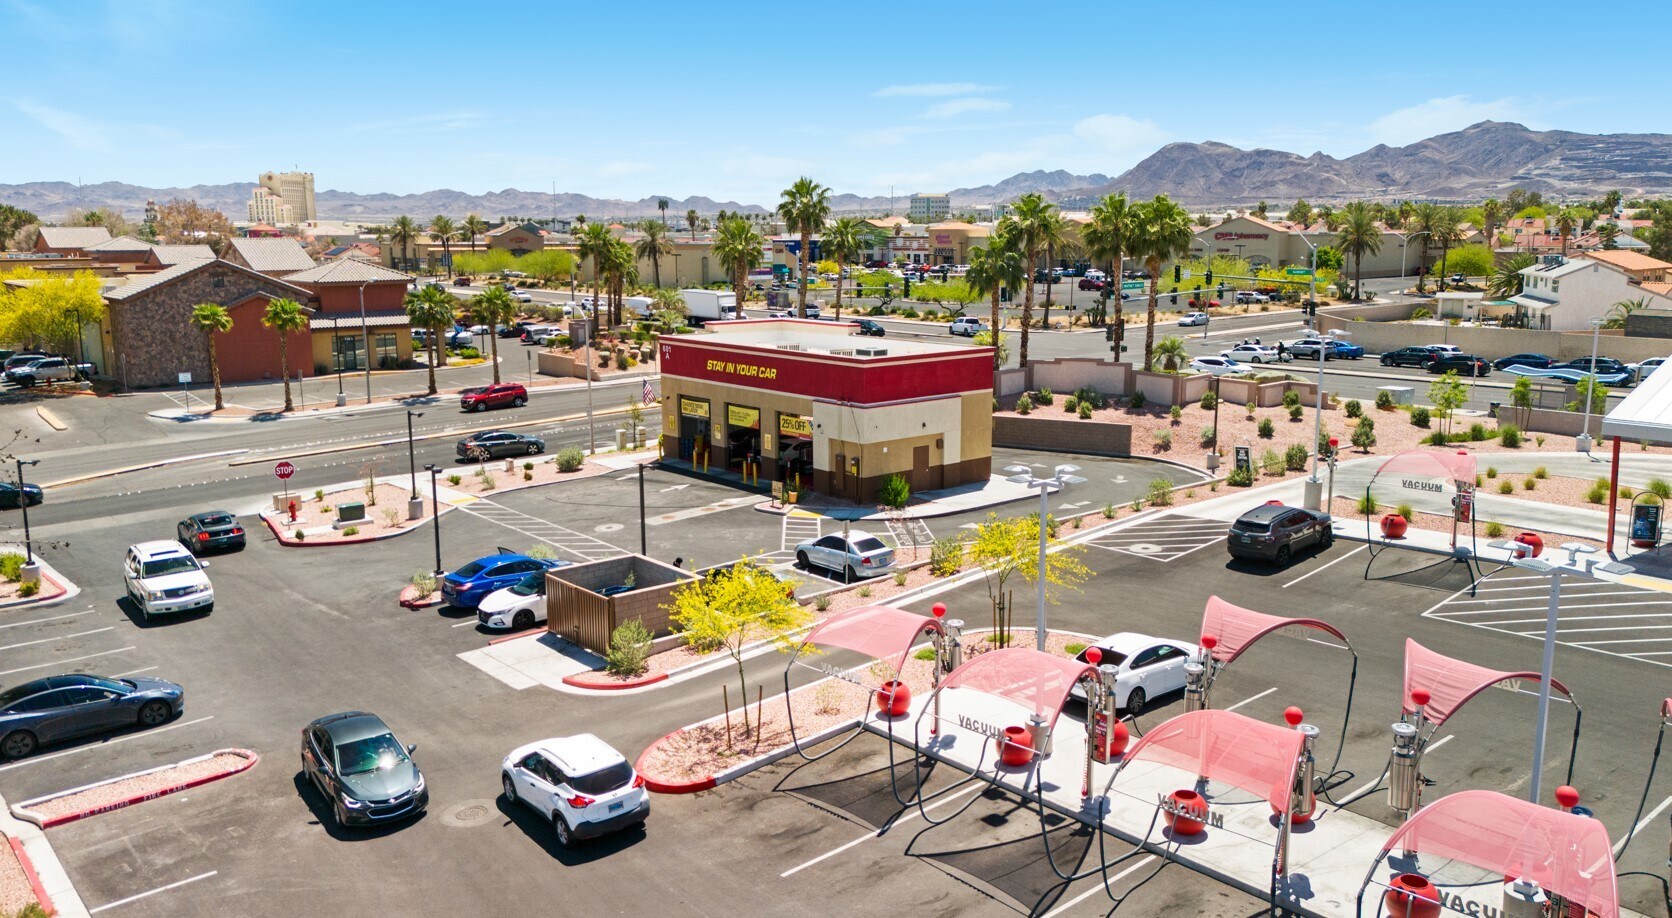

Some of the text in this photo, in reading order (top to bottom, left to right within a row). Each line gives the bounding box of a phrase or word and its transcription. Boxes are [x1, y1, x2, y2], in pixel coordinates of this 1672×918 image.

[706, 360, 777, 379] STAY IN YOUR CAR
[781, 418, 807, 431] 25% OFF
[276, 466, 293, 475] STOP
[1402, 479, 1443, 493] VACUUM
[958, 713, 1005, 742] VACUUM
[94, 799, 130, 815] PARKING
[1157, 792, 1225, 830] VACUUM
